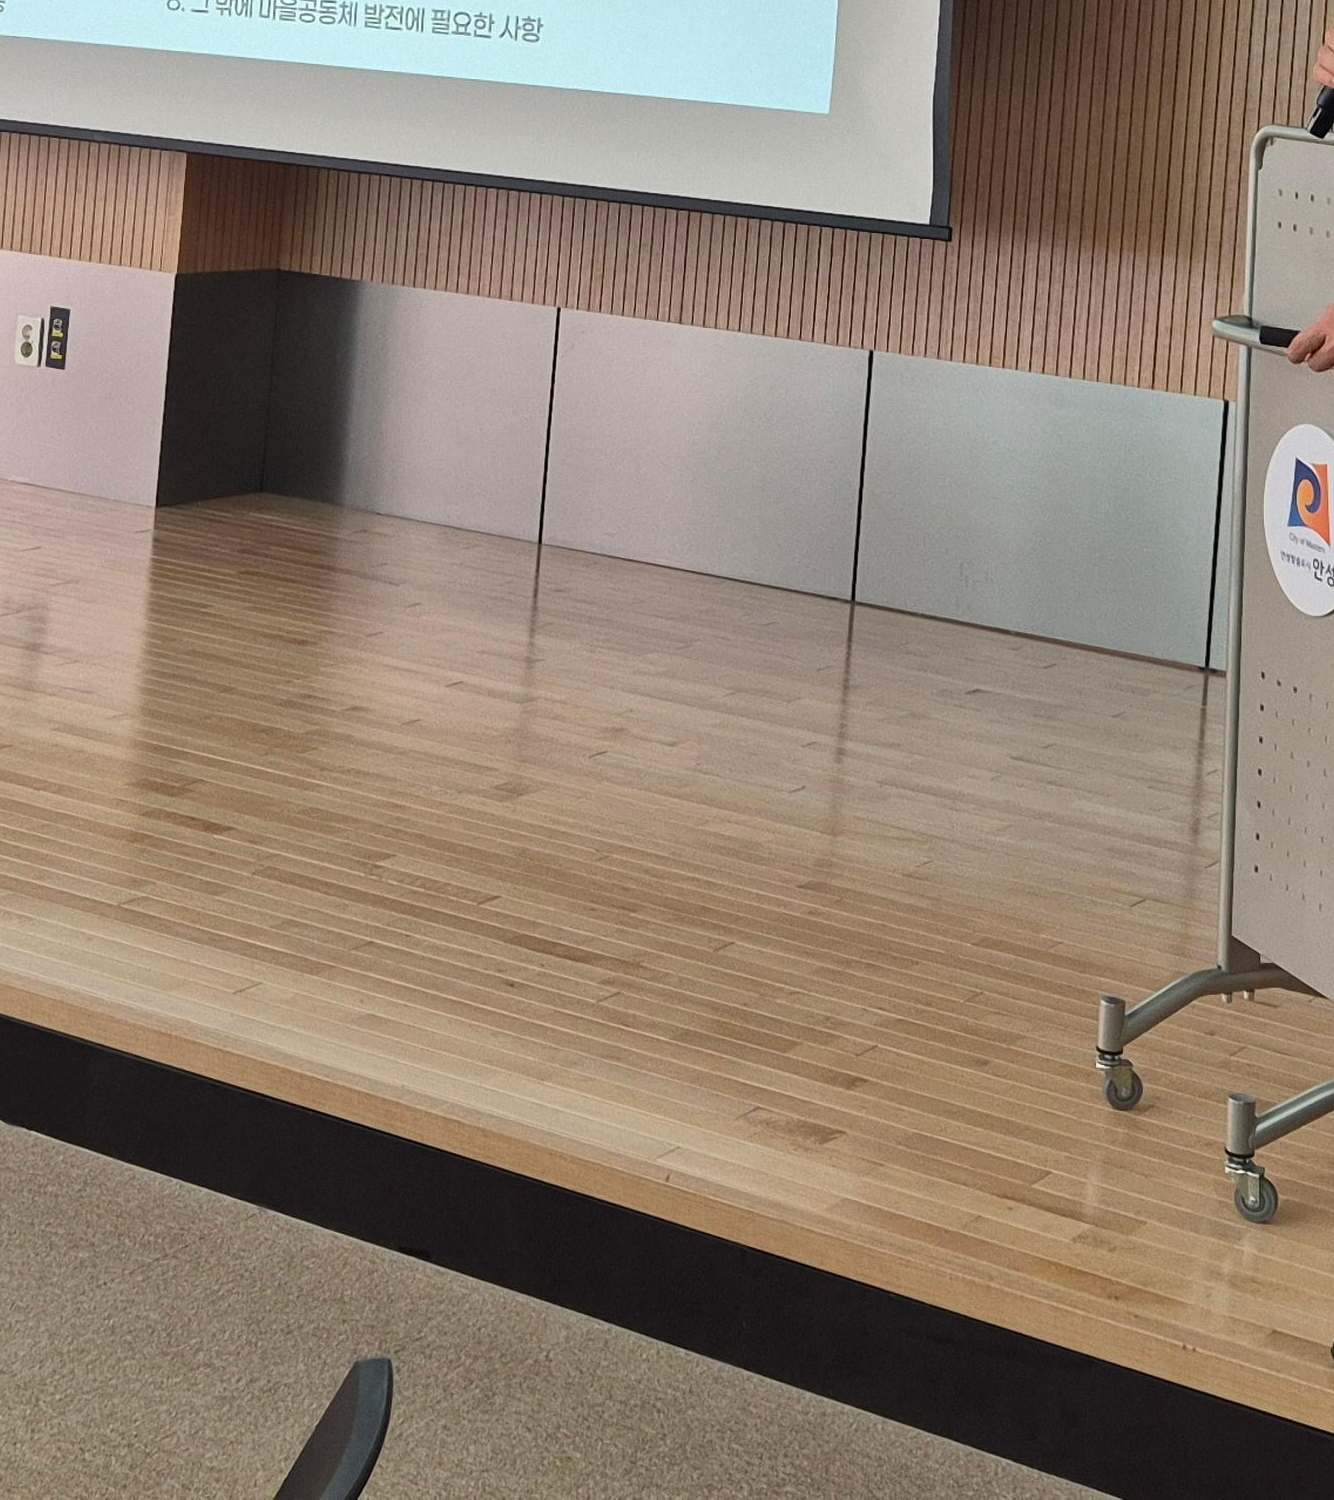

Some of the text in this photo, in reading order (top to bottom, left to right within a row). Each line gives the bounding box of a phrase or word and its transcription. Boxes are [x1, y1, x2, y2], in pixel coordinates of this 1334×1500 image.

[364, 3, 425, 33] 발전에
[430, 9, 495, 39] 필요한
[498, 15, 543, 43] 사항
